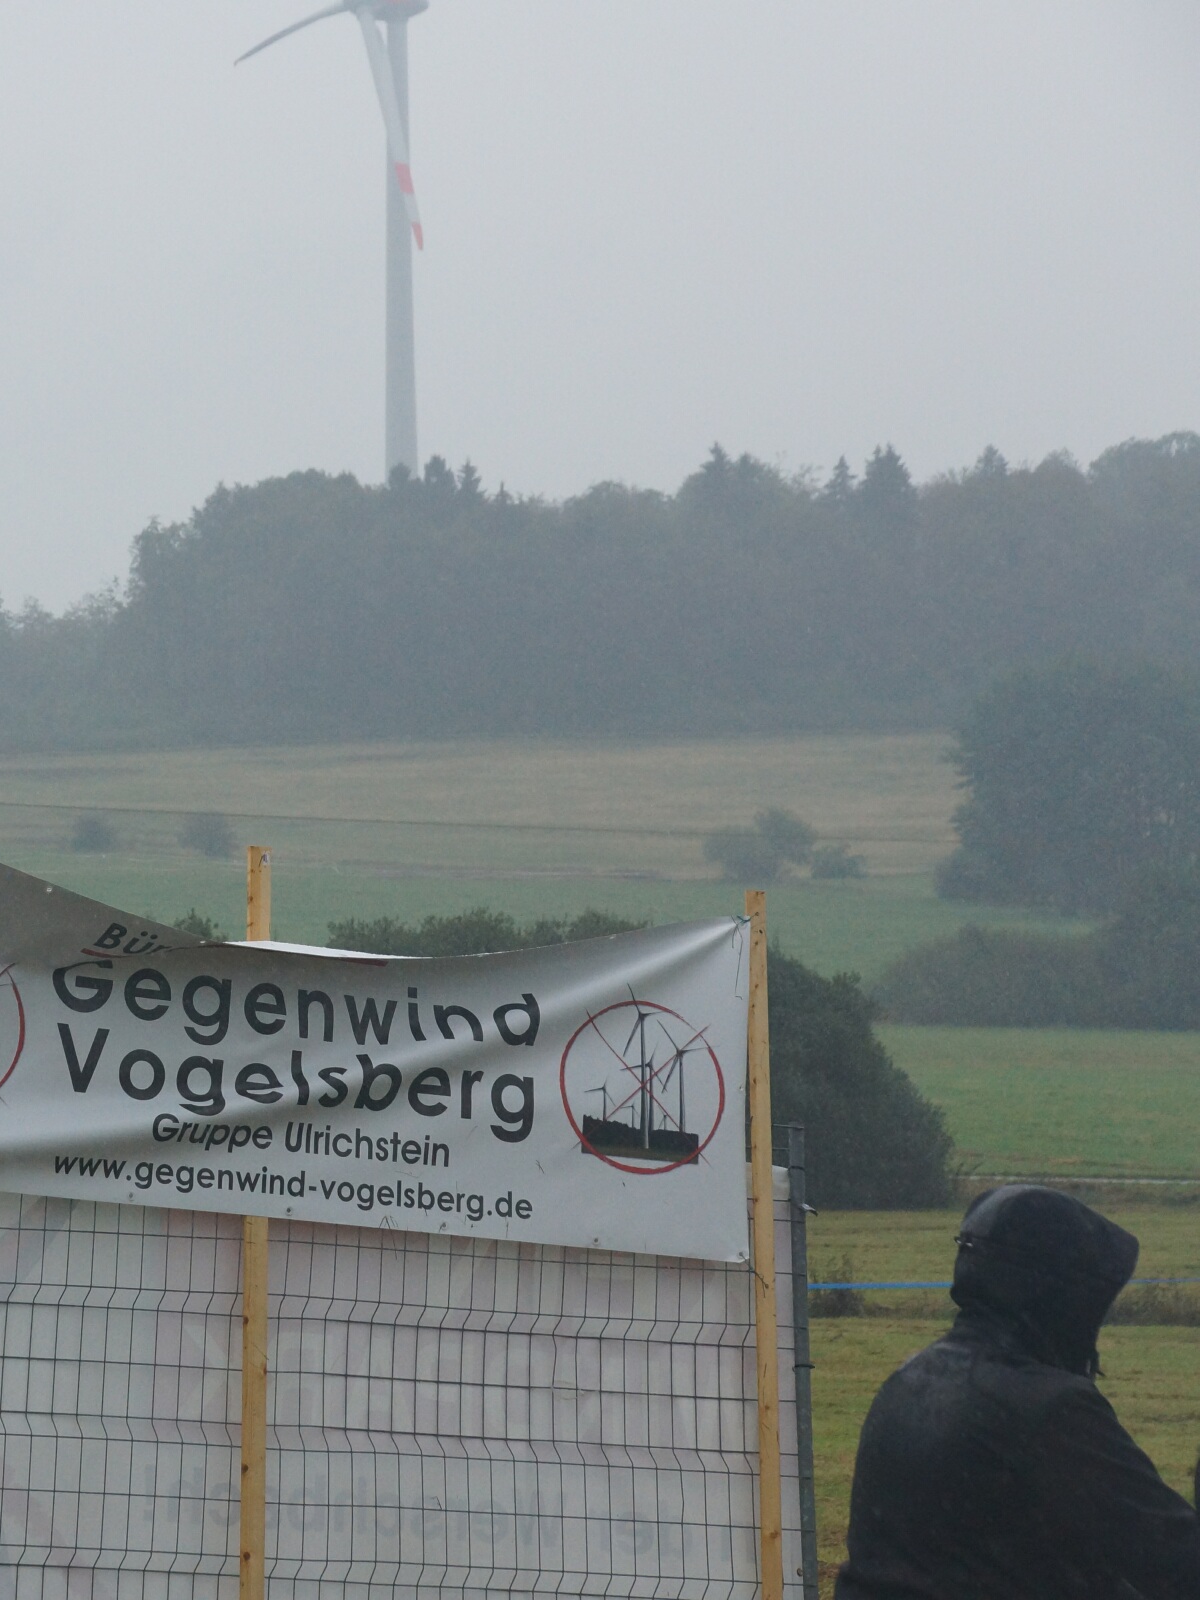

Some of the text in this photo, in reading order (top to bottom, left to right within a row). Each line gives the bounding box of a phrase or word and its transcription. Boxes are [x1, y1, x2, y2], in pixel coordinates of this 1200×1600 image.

[52, 960, 541, 1047] Gegenwind
[56, 1022, 535, 1143] Vogelsberg
[152, 1113, 273, 1153] Gruppe
[284, 1121, 450, 1168] Ulrichstein
[54, 1155, 533, 1222] www.gegenwind-vogelsberg.de
